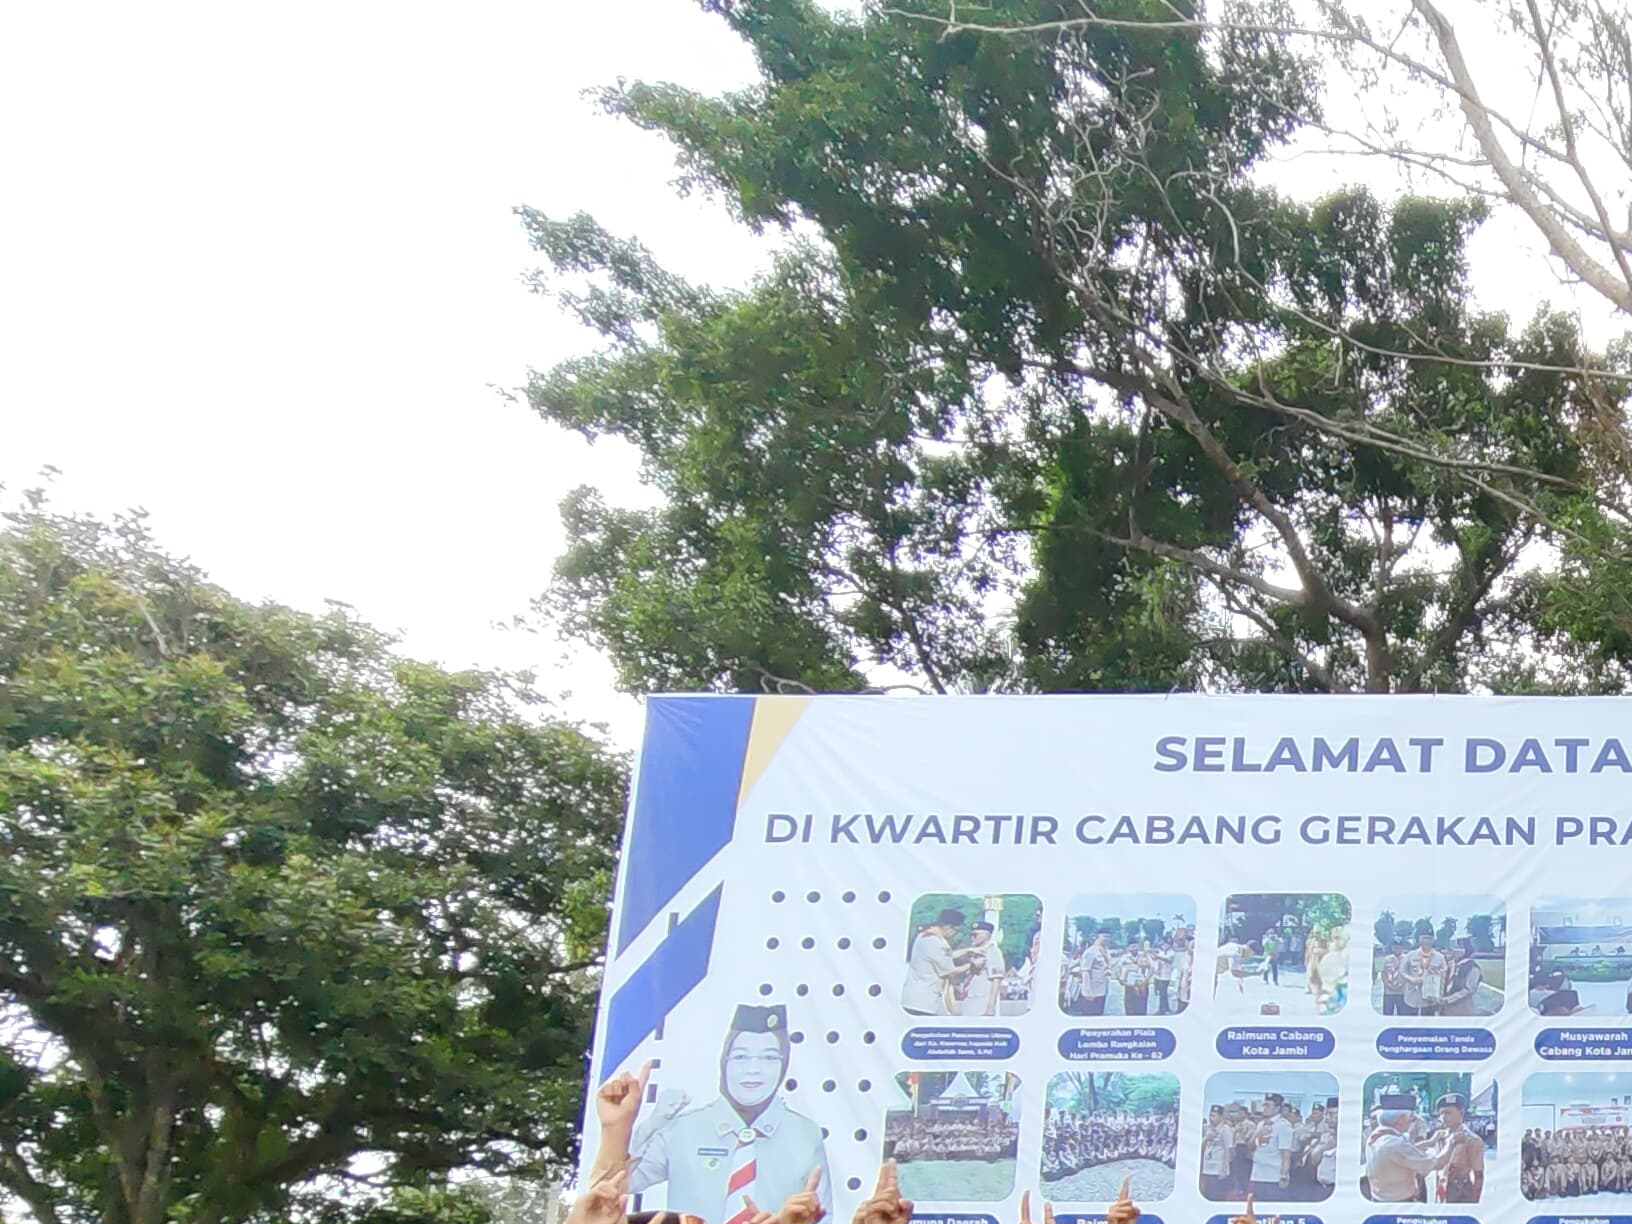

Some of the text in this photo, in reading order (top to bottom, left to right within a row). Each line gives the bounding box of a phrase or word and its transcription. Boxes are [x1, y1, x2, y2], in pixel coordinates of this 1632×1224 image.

[1153, 736, 1444, 773] SELAMAT
[765, 814, 813, 843] DI
[830, 814, 1059, 844] KWARTIR
[1075, 815, 1282, 845] CABANG
[1299, 815, 1536, 845] GERAKAN
[1080, 1029, 1132, 1038] Penyerahan
[1227, 1031, 1324, 1042] Raimuna Cabang
[1560, 1031, 1628, 1042] Musyawarah
[1077, 1040, 1157, 1049] Lomba Rangkaian
[1242, 1045, 1308, 1056] Kota Jambi
[1539, 1046, 1582, 1056] Cabang
[1585, 1046, 1612, 1055] Kota
